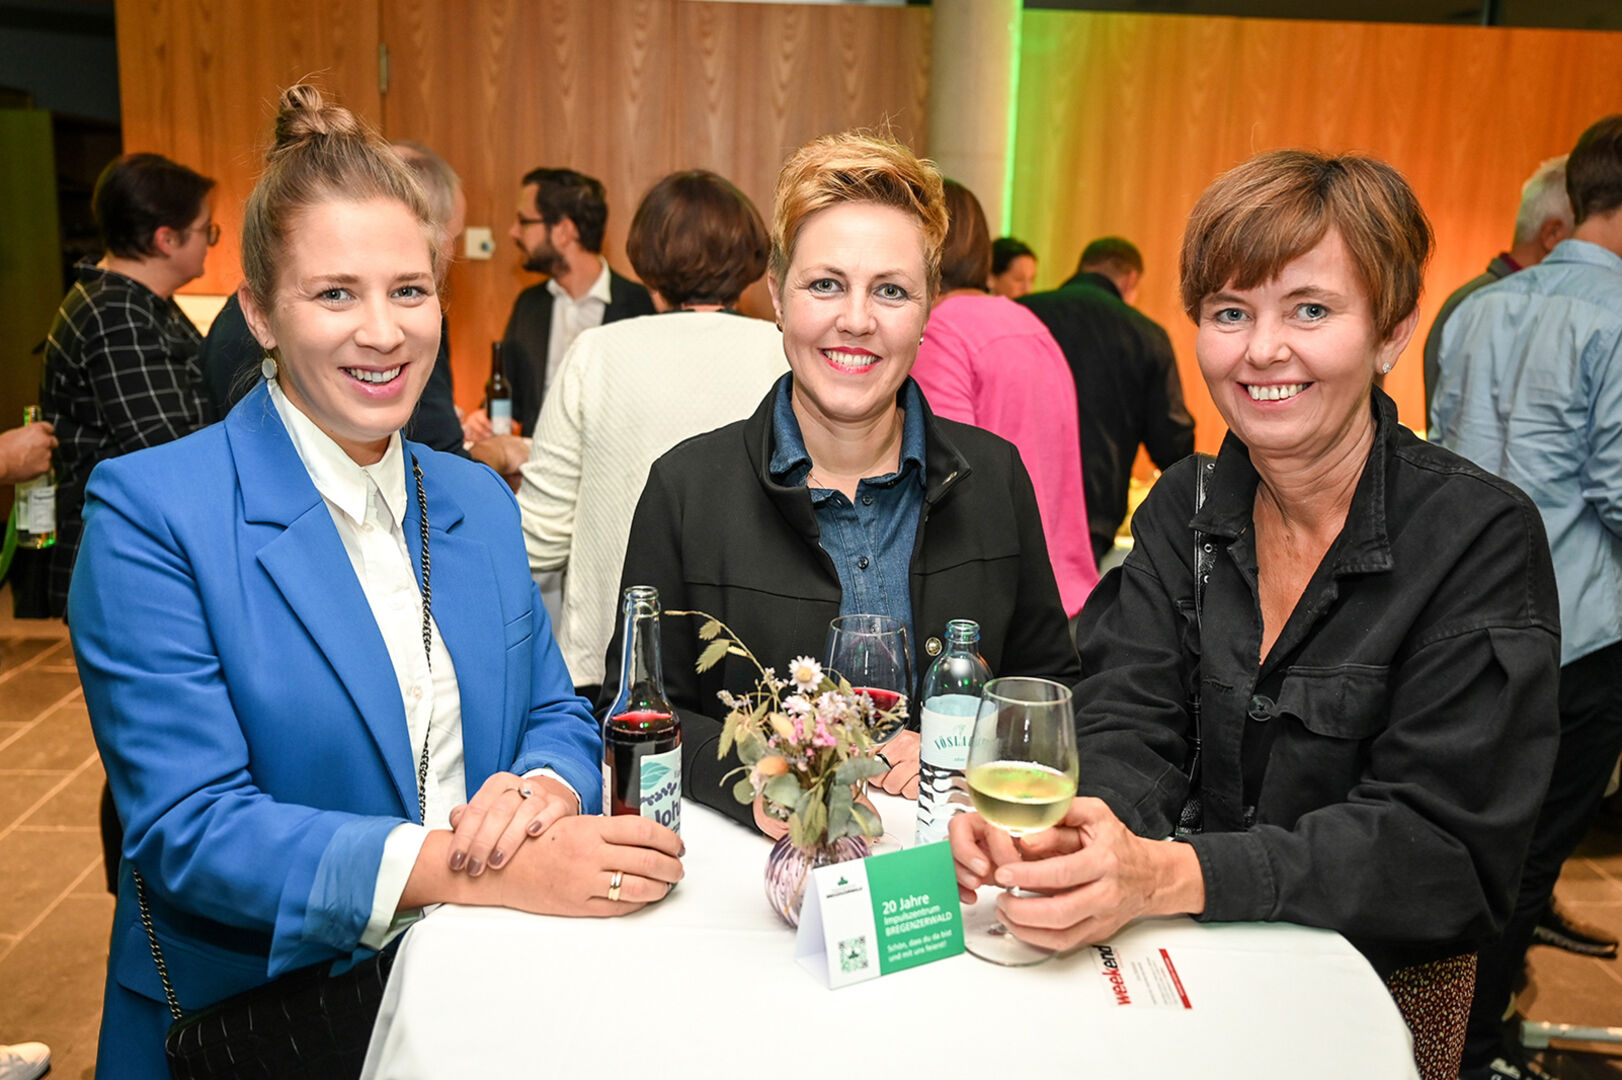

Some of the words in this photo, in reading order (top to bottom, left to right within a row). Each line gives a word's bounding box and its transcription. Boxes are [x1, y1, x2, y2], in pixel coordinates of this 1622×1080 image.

[882, 899, 897, 915] 20
[899, 894, 930, 911] Jahre
[883, 905, 941, 925] Impulszentrum
[885, 911, 953, 937] BREGENZERWALD
[1092, 945, 1131, 1005] weekend
